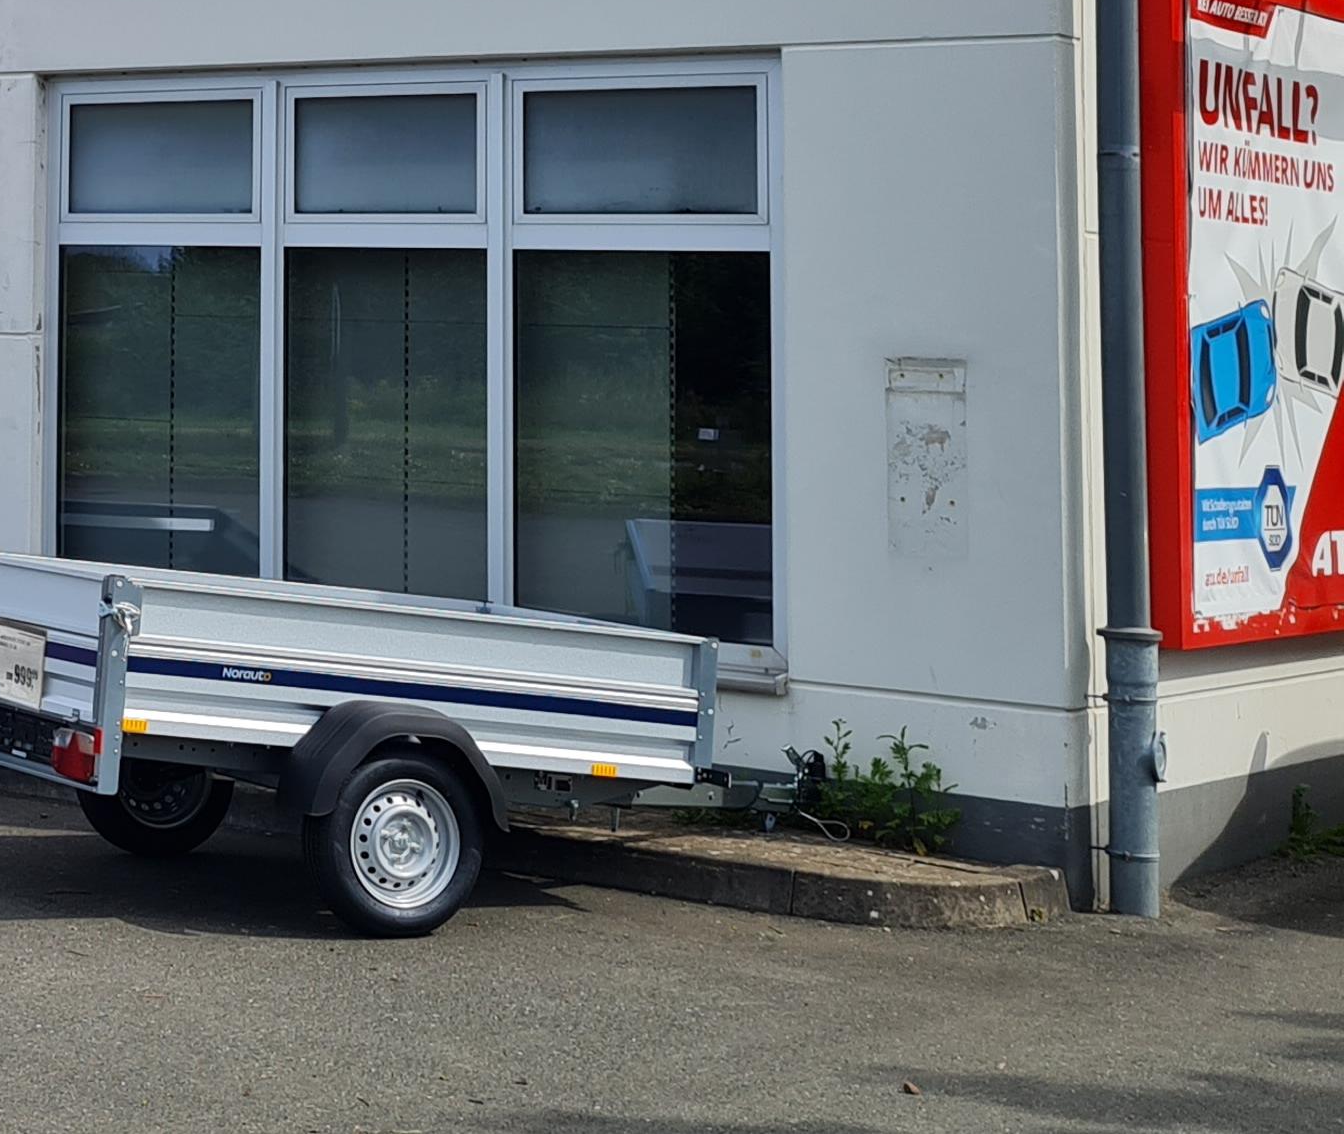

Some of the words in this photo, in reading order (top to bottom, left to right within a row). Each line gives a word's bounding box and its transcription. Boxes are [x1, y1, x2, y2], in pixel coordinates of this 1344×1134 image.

[1199, 59, 1319, 146] UNFALL?
[1198, 140, 1229, 176] WIR
[1233, 140, 1300, 187] KÜMMERN
[1303, 159, 1335, 192] UNS
[1198, 186, 1223, 220] UM
[1225, 190, 1269, 226] ALLES!
[221, 667, 272, 682] Norauto
